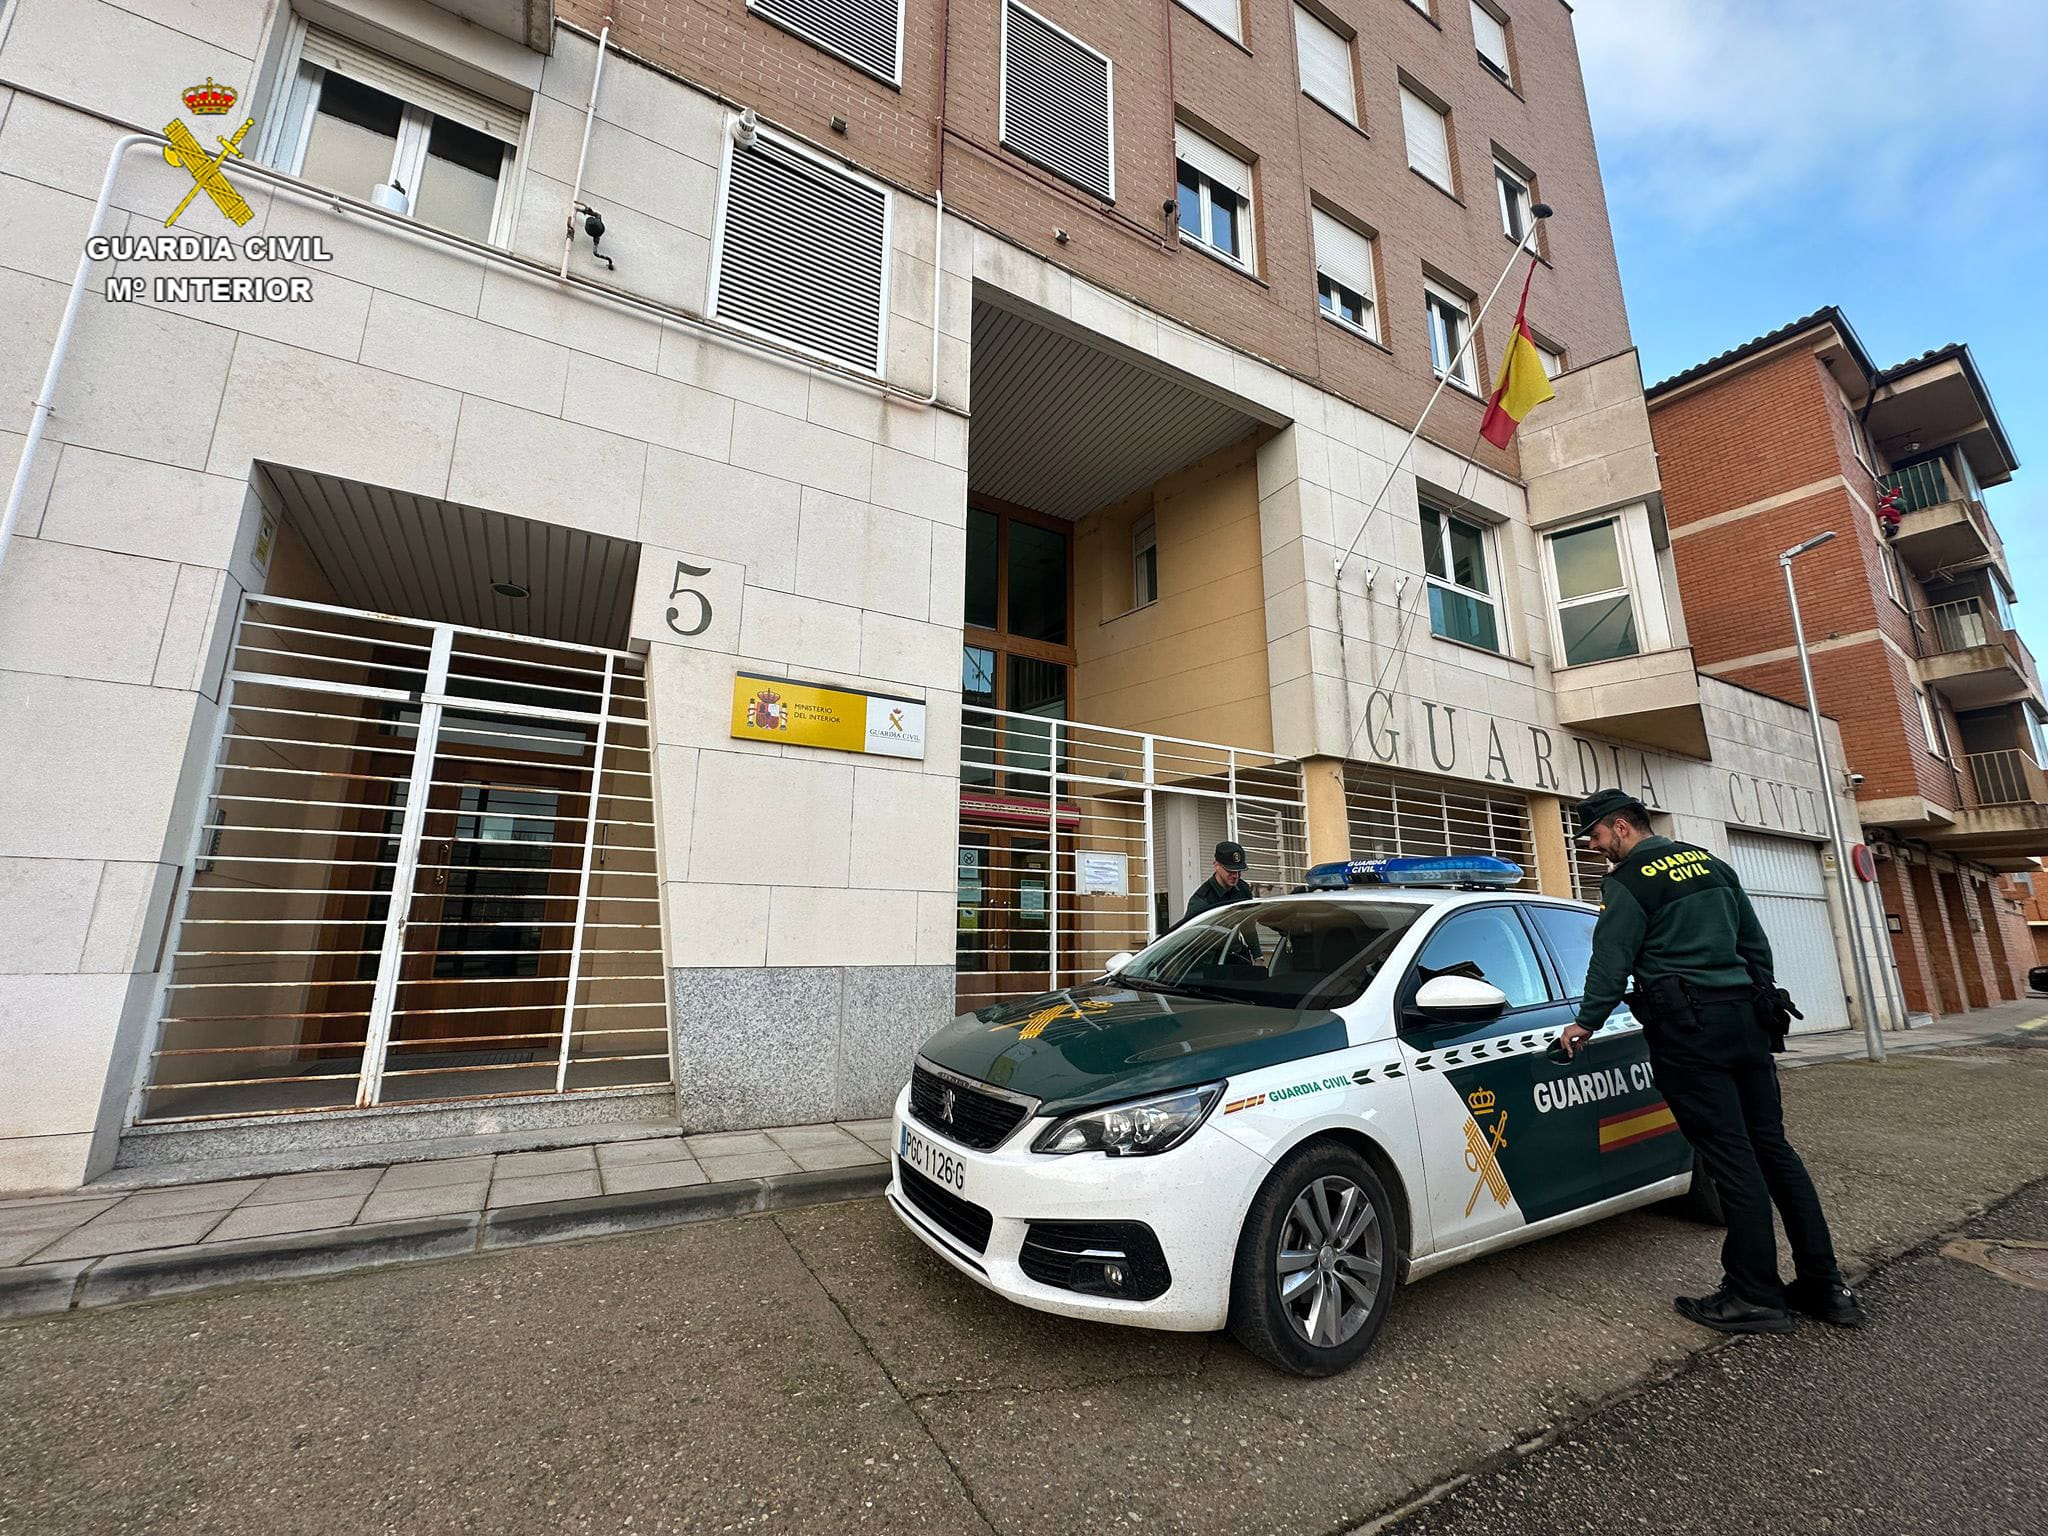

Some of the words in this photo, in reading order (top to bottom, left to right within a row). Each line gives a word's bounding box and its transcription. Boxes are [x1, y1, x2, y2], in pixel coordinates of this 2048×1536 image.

[666, 560, 713, 636] 5
[793, 711, 807, 720] DEL
[809, 713, 841, 724] INTERIOR
[794, 703, 833, 714] MINISTERIO
[869, 728, 901, 739] GUARDIA
[902, 733, 920, 741] CIVIL
[1365, 690, 1661, 809] GUARDIA
[1728, 773, 1827, 835] CIVIL
[1347, 859, 1387, 867] GUARDIA
[1641, 850, 1711, 877] GUARDIA
[1669, 863, 1710, 881] CIVIL
[1269, 1081, 1322, 1102] GUARDIA
[1322, 1075, 1352, 1090] CIVIL
[1533, 1068, 1630, 1113] GUARDIA
[907, 1131, 922, 1166] PGC
